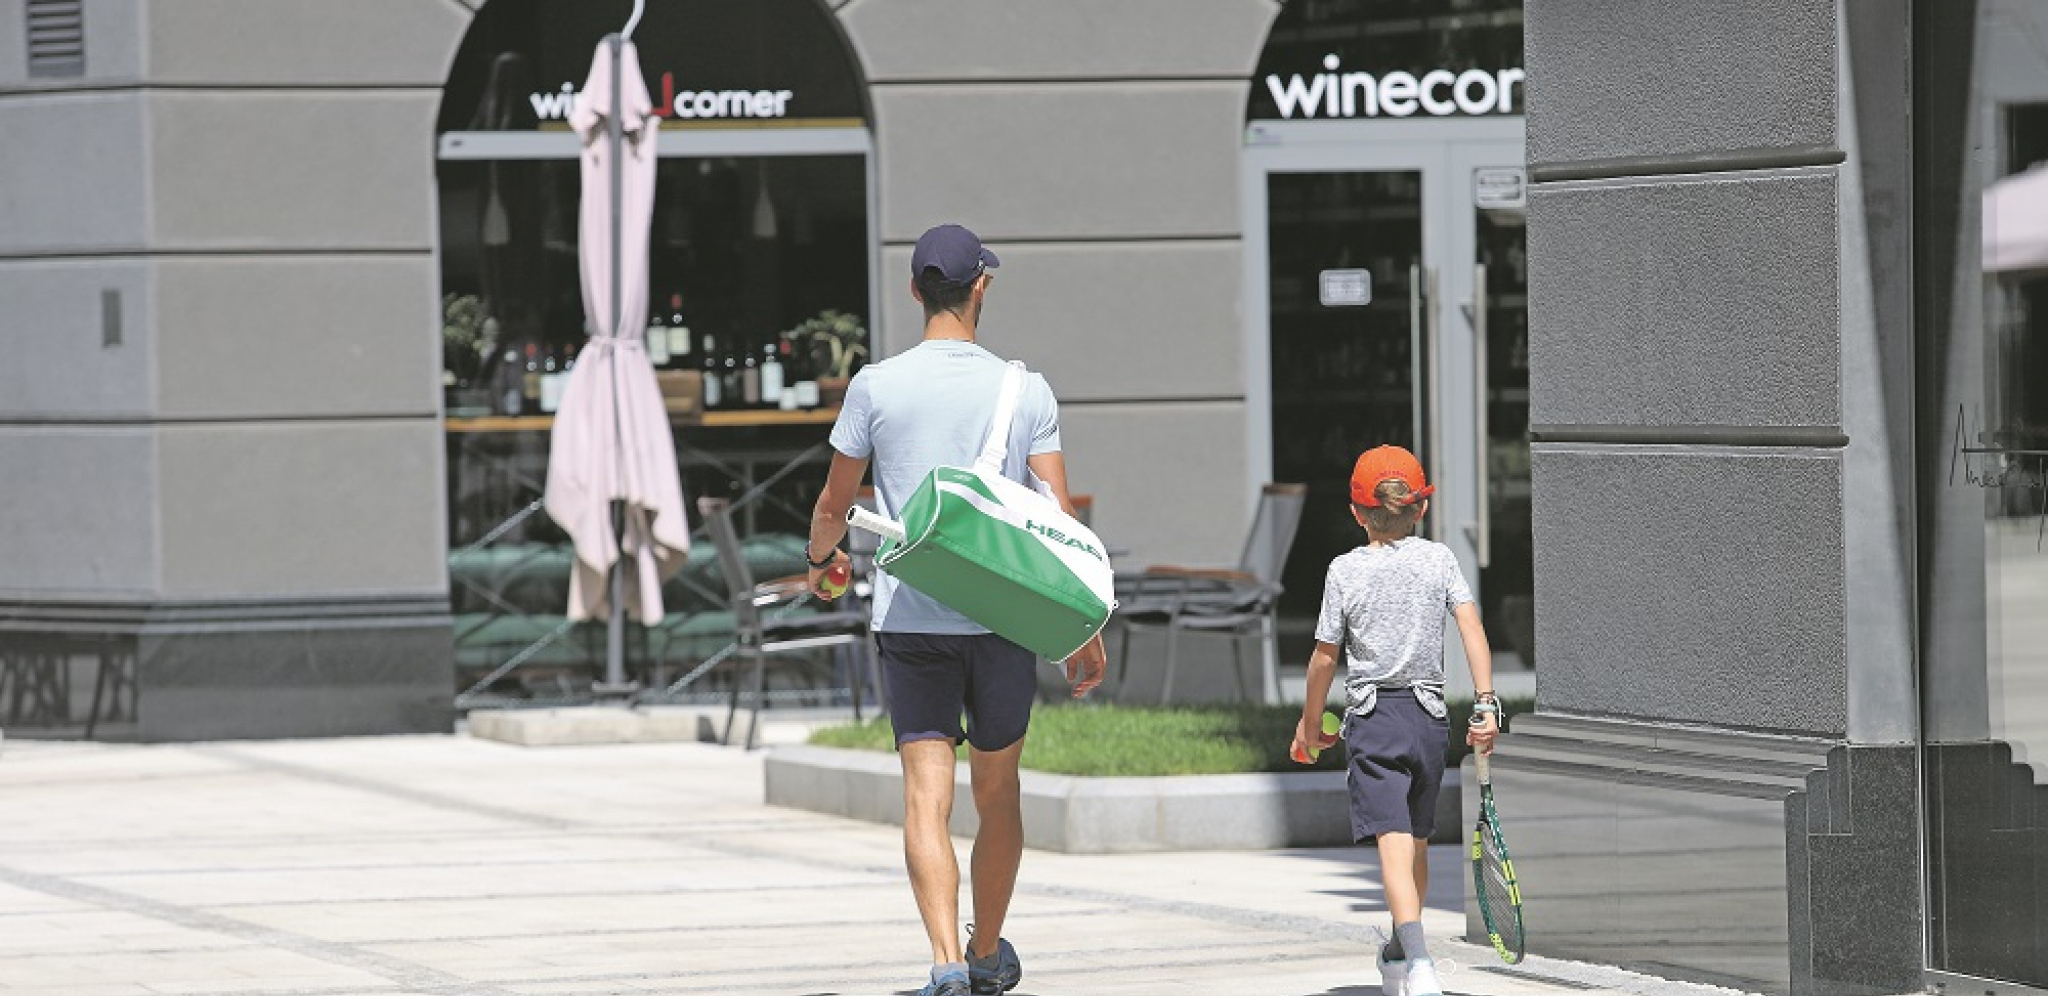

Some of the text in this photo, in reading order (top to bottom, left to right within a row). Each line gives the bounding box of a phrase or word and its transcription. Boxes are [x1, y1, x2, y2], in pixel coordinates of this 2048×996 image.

[530, 81, 793, 119] wi corner
[1266, 53, 1524, 118] winecor
